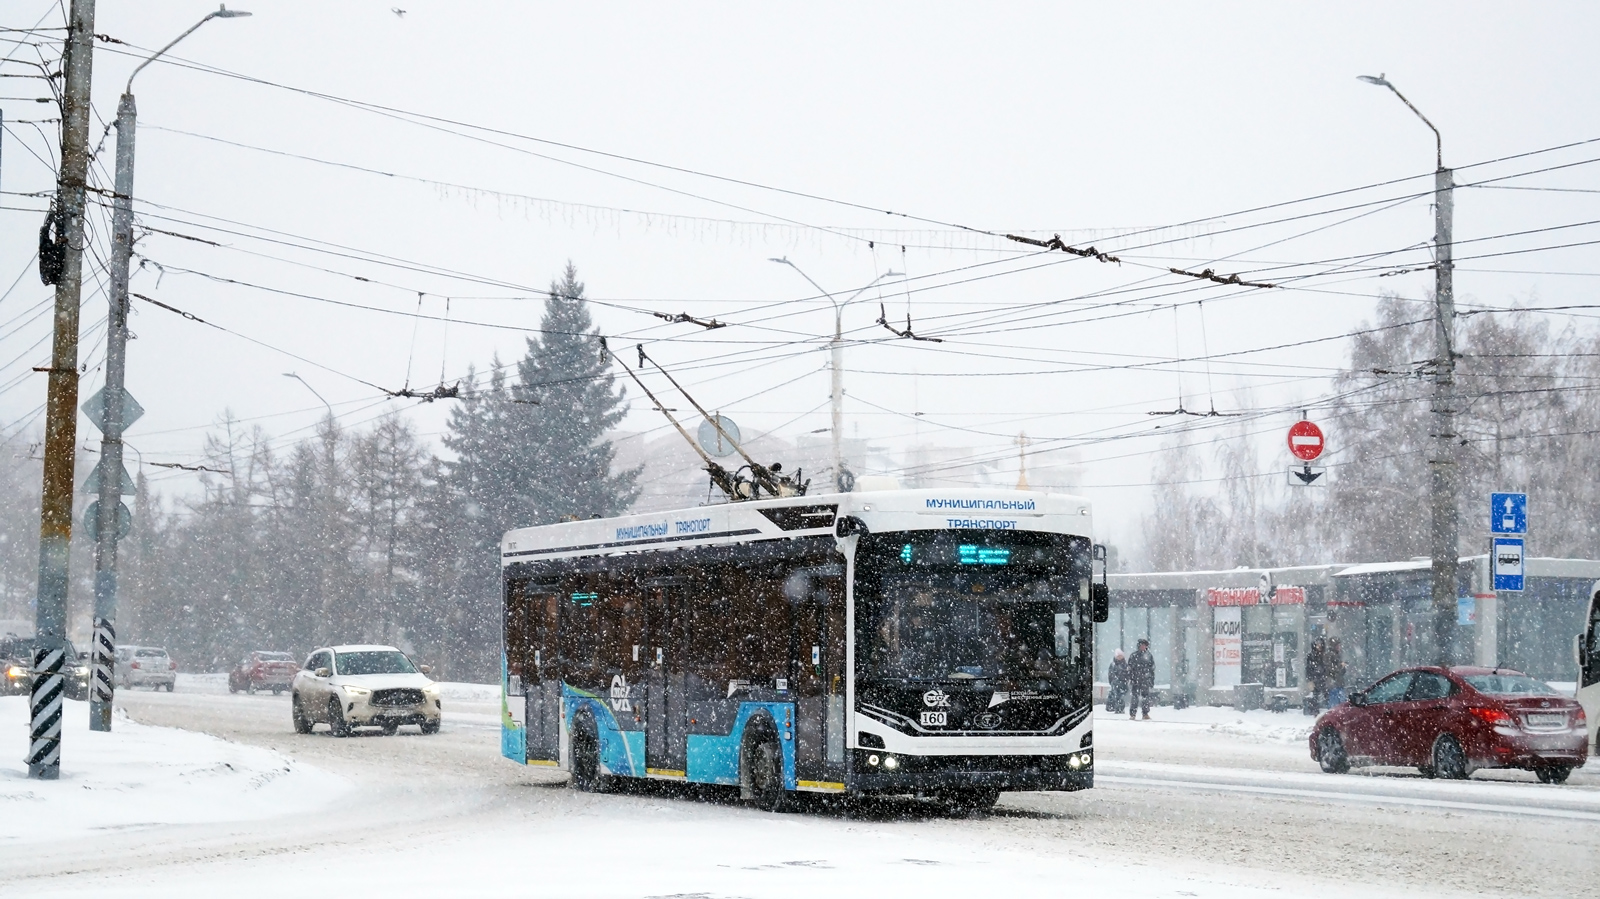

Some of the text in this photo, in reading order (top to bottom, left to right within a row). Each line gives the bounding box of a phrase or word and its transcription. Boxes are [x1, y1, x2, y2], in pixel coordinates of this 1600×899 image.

[926, 498, 1035, 511] МУНИЦИПАЛЬНЫЙ
[616, 518, 711, 540] МУНИЦИПАЛЬНЫЙ ТРАНСПОРТ
[947, 518, 1018, 530] ТРАНСПОРТ
[1214, 621, 1241, 636] ЛЮДИ
[922, 712, 945, 724] 160
